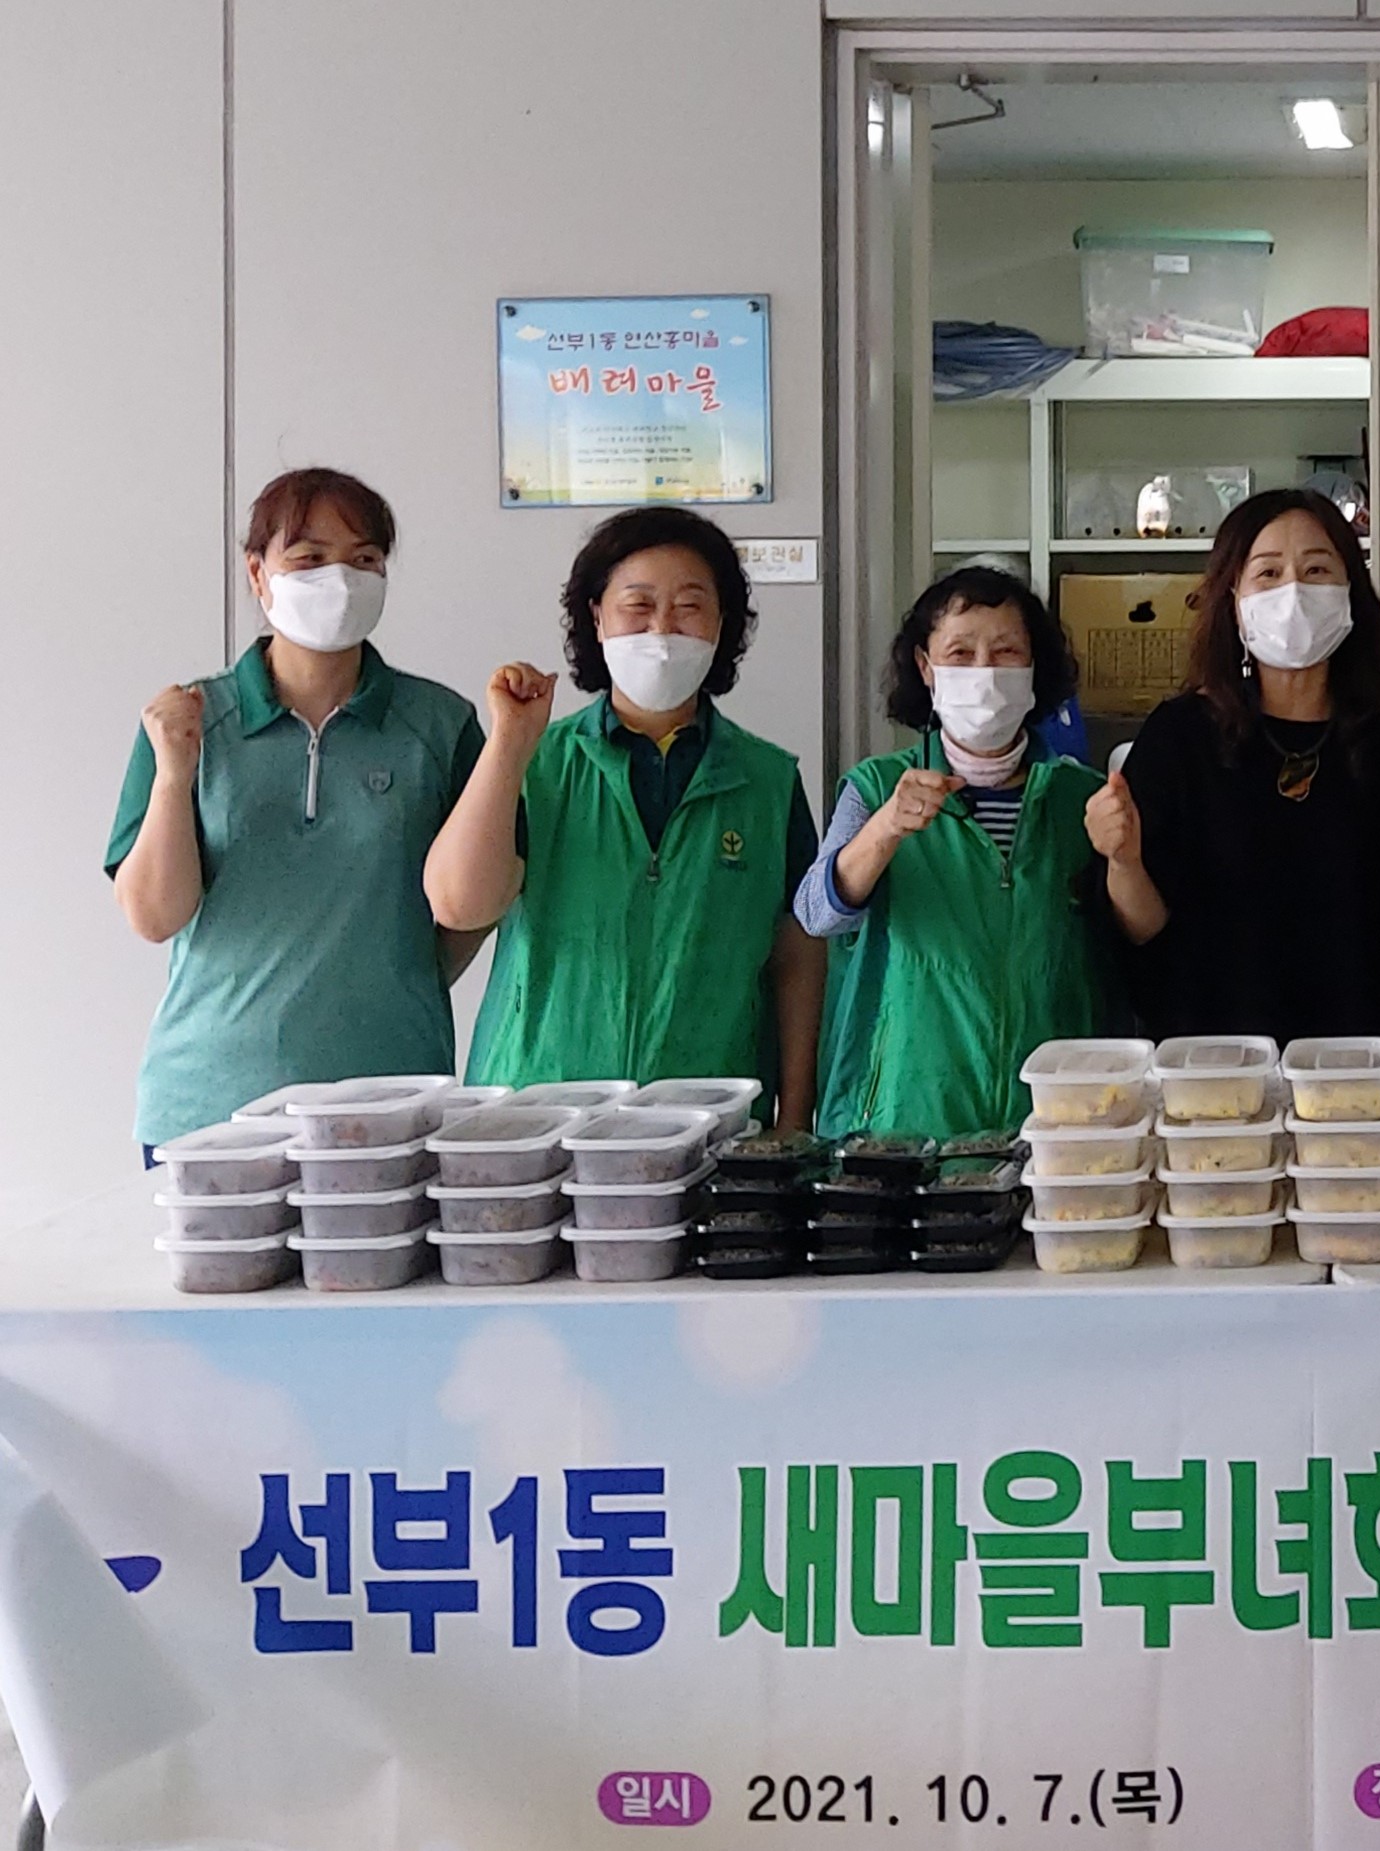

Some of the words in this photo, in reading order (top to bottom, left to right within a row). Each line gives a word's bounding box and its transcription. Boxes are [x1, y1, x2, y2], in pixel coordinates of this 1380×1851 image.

[546, 331, 617, 352] 선부1동
[240, 1467, 674, 1657] 선부1동
[616, 1777, 691, 1818] 일시
[747, 1774, 900, 1827] 2021.
[926, 1773, 1008, 1826] 10.
